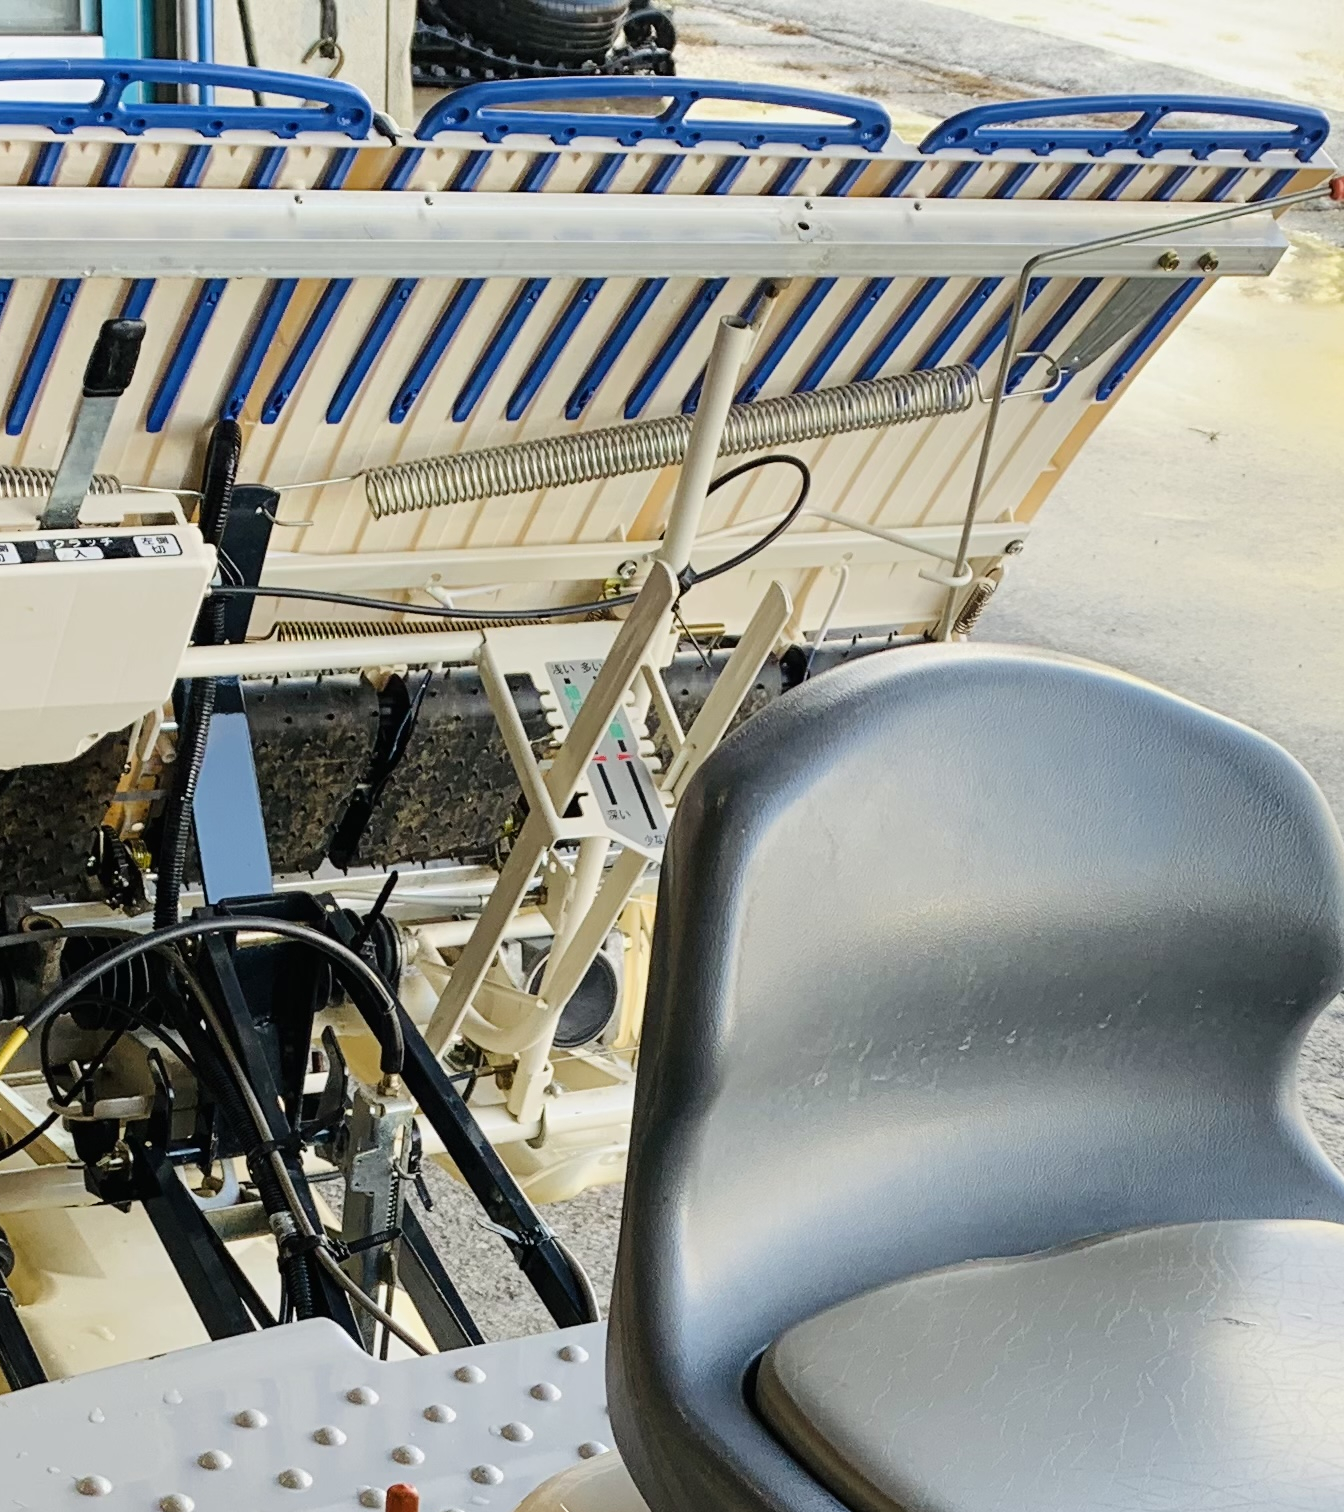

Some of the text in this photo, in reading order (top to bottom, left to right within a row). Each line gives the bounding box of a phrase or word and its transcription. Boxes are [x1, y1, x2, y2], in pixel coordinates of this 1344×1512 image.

[36, 538, 113, 550] クラッチ
[75, 549, 88, 559] 入
